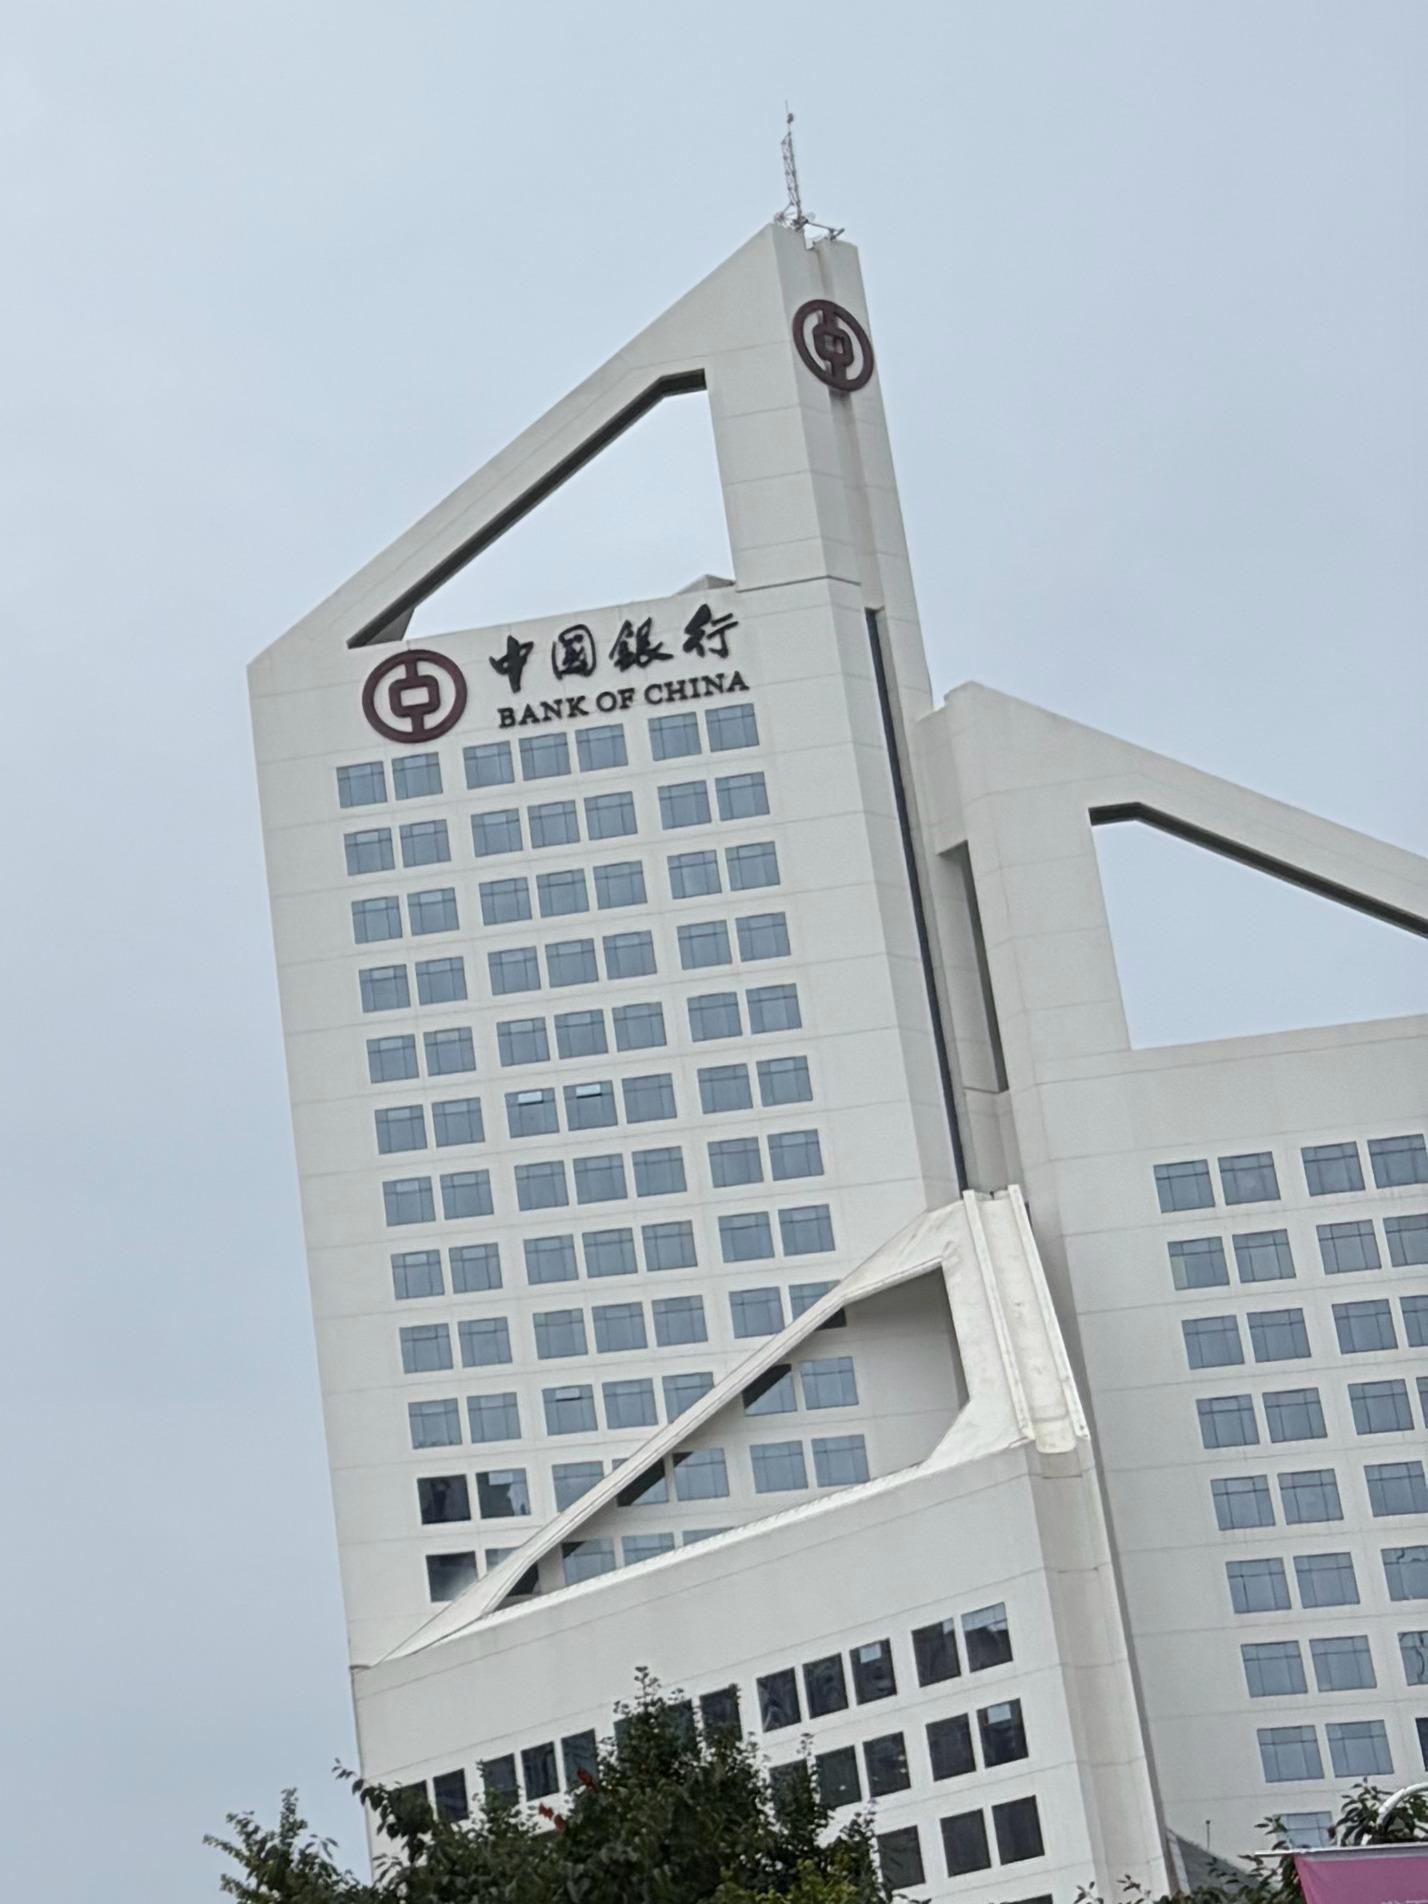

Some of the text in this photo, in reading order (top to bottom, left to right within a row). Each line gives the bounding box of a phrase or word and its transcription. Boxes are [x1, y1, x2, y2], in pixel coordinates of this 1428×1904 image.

[497, 670, 750, 729] BANK OF CHINA
